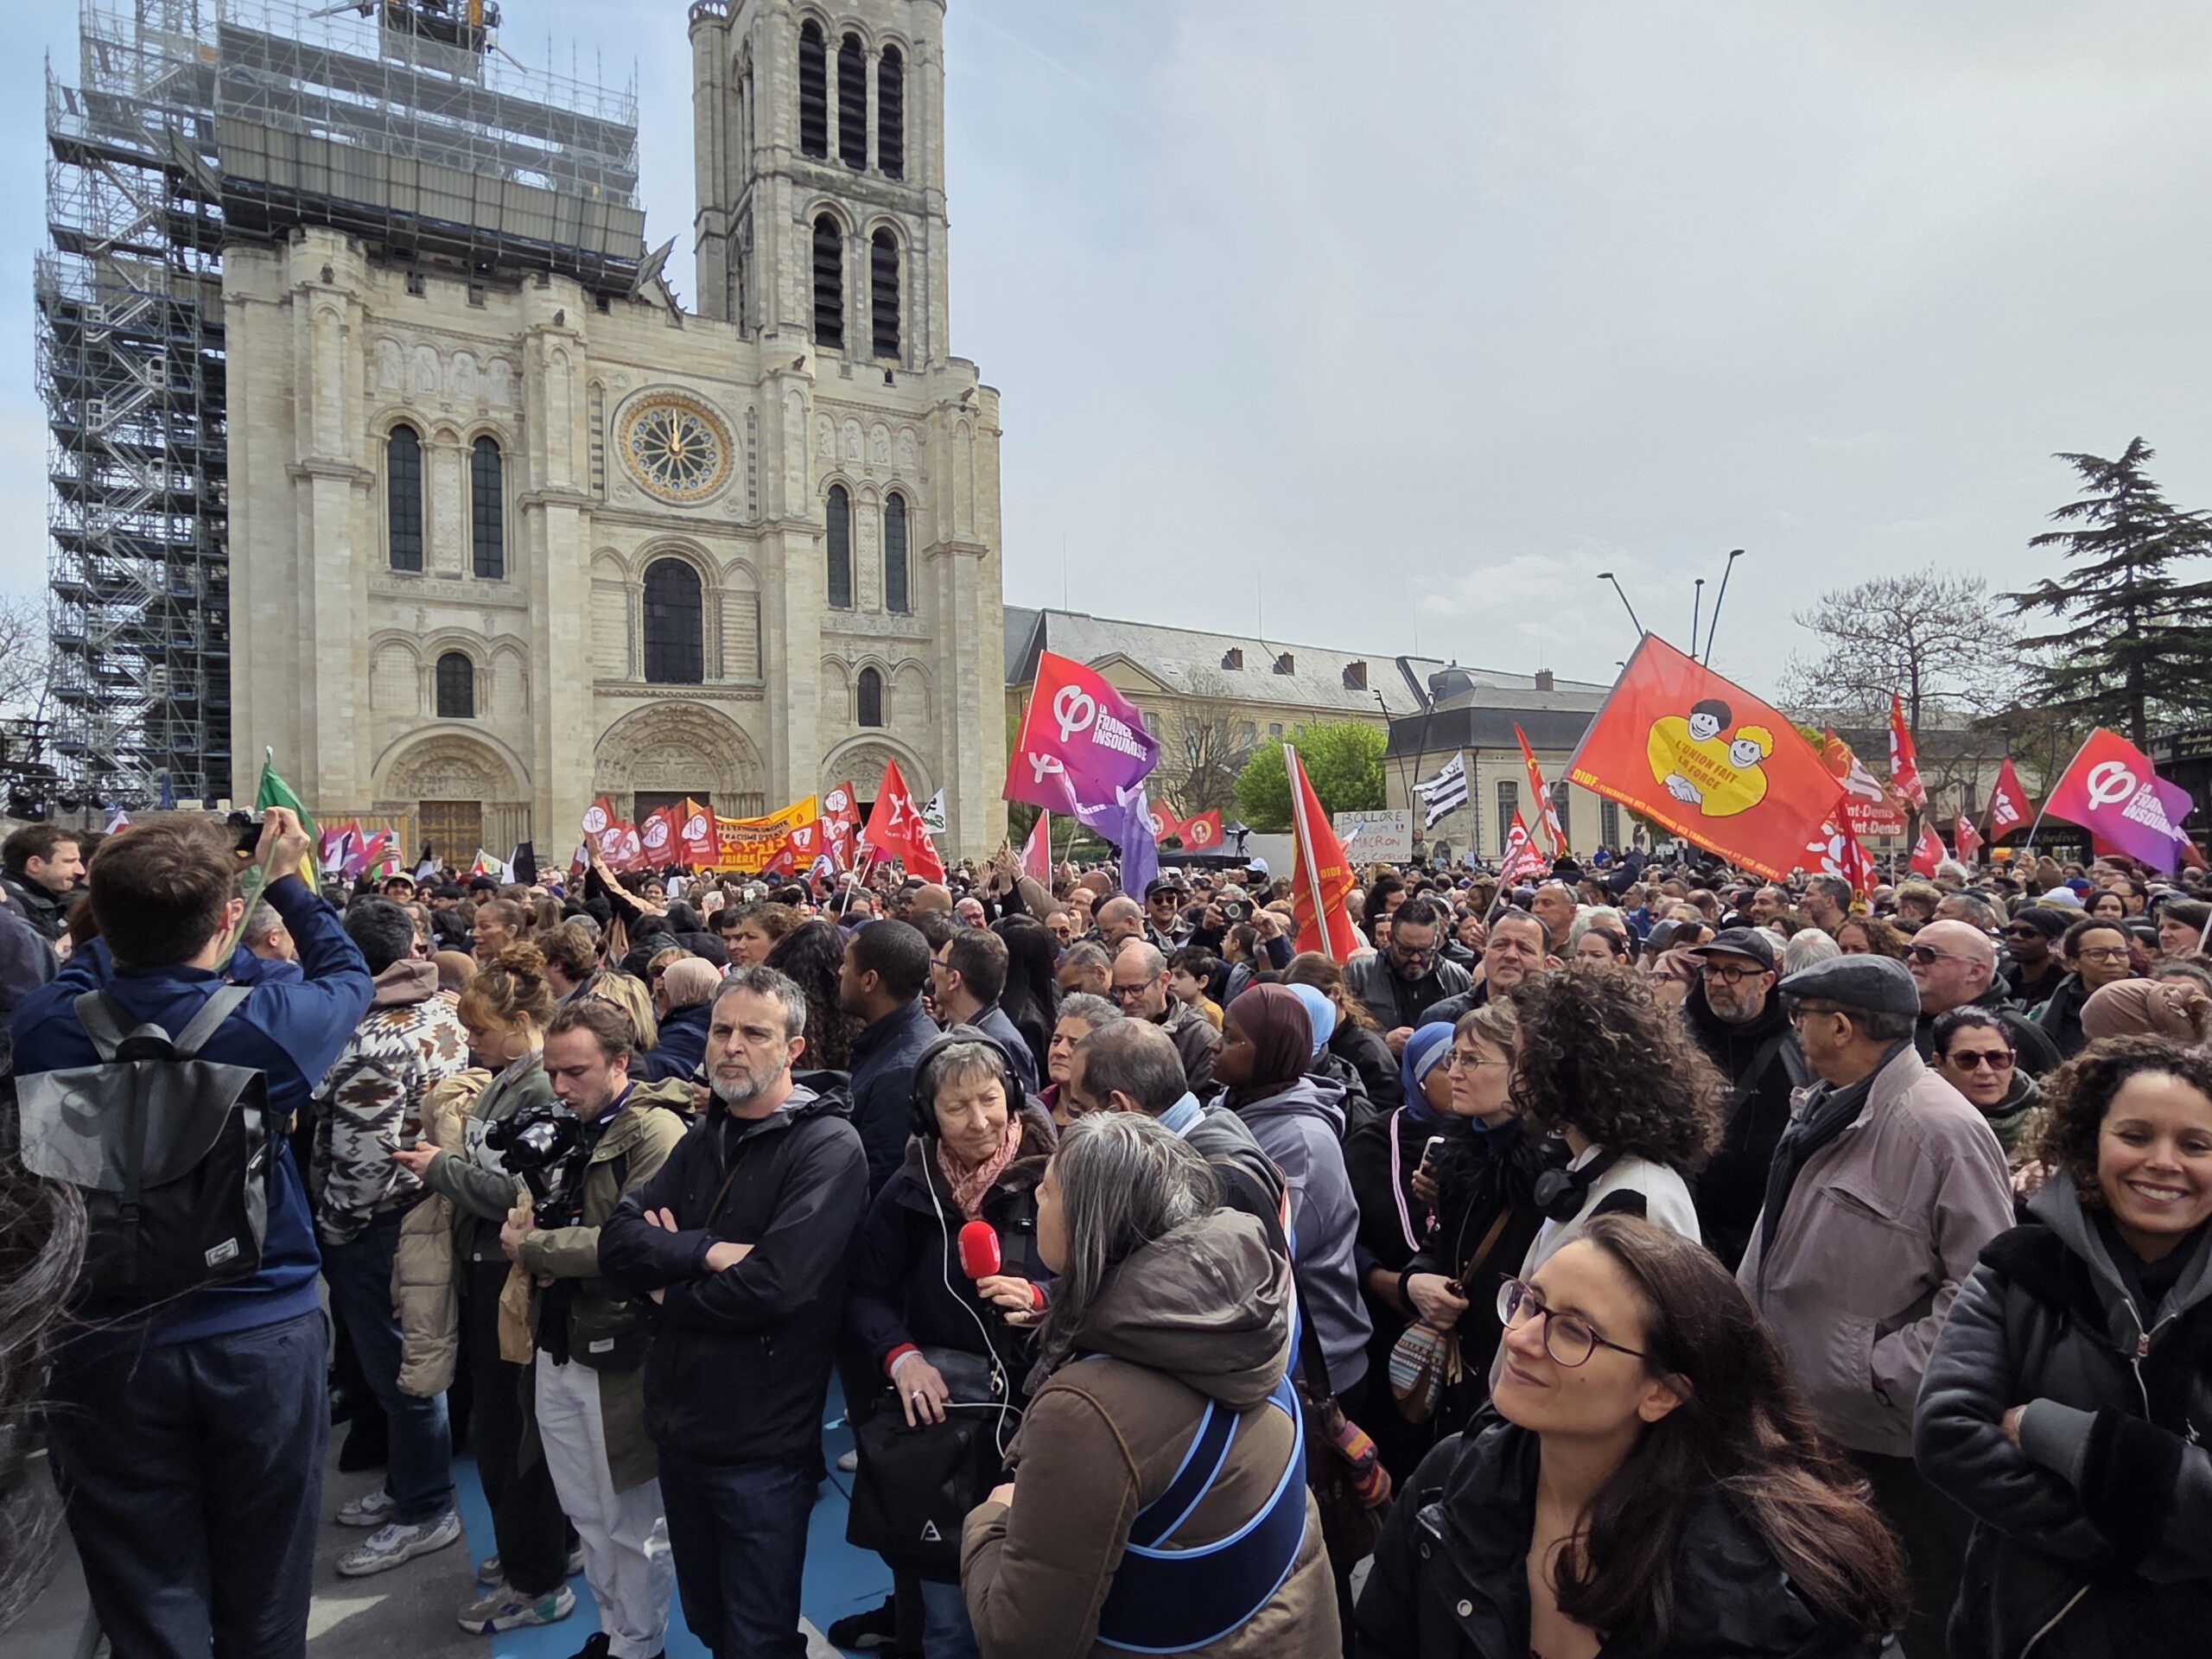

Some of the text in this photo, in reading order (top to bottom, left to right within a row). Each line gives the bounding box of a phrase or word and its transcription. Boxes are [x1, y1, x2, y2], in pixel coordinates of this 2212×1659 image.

[1099, 702, 1108, 715] LA
[1095, 713, 1134, 741] FRANCE
[1091, 728, 1147, 762] INSOUMISE
[1675, 740, 1738, 784] L'UNION FAIT
[1572, 767, 1599, 787] DIDF
[1678, 754, 1722, 791] LA FORCE
[2139, 782, 2153, 794] LA
[1846, 803, 1895, 819] nt-Denis
[1852, 820, 1902, 835] int-Denis
[2120, 804, 2178, 842] INSOUM
[1345, 851, 1367, 862] OUS
